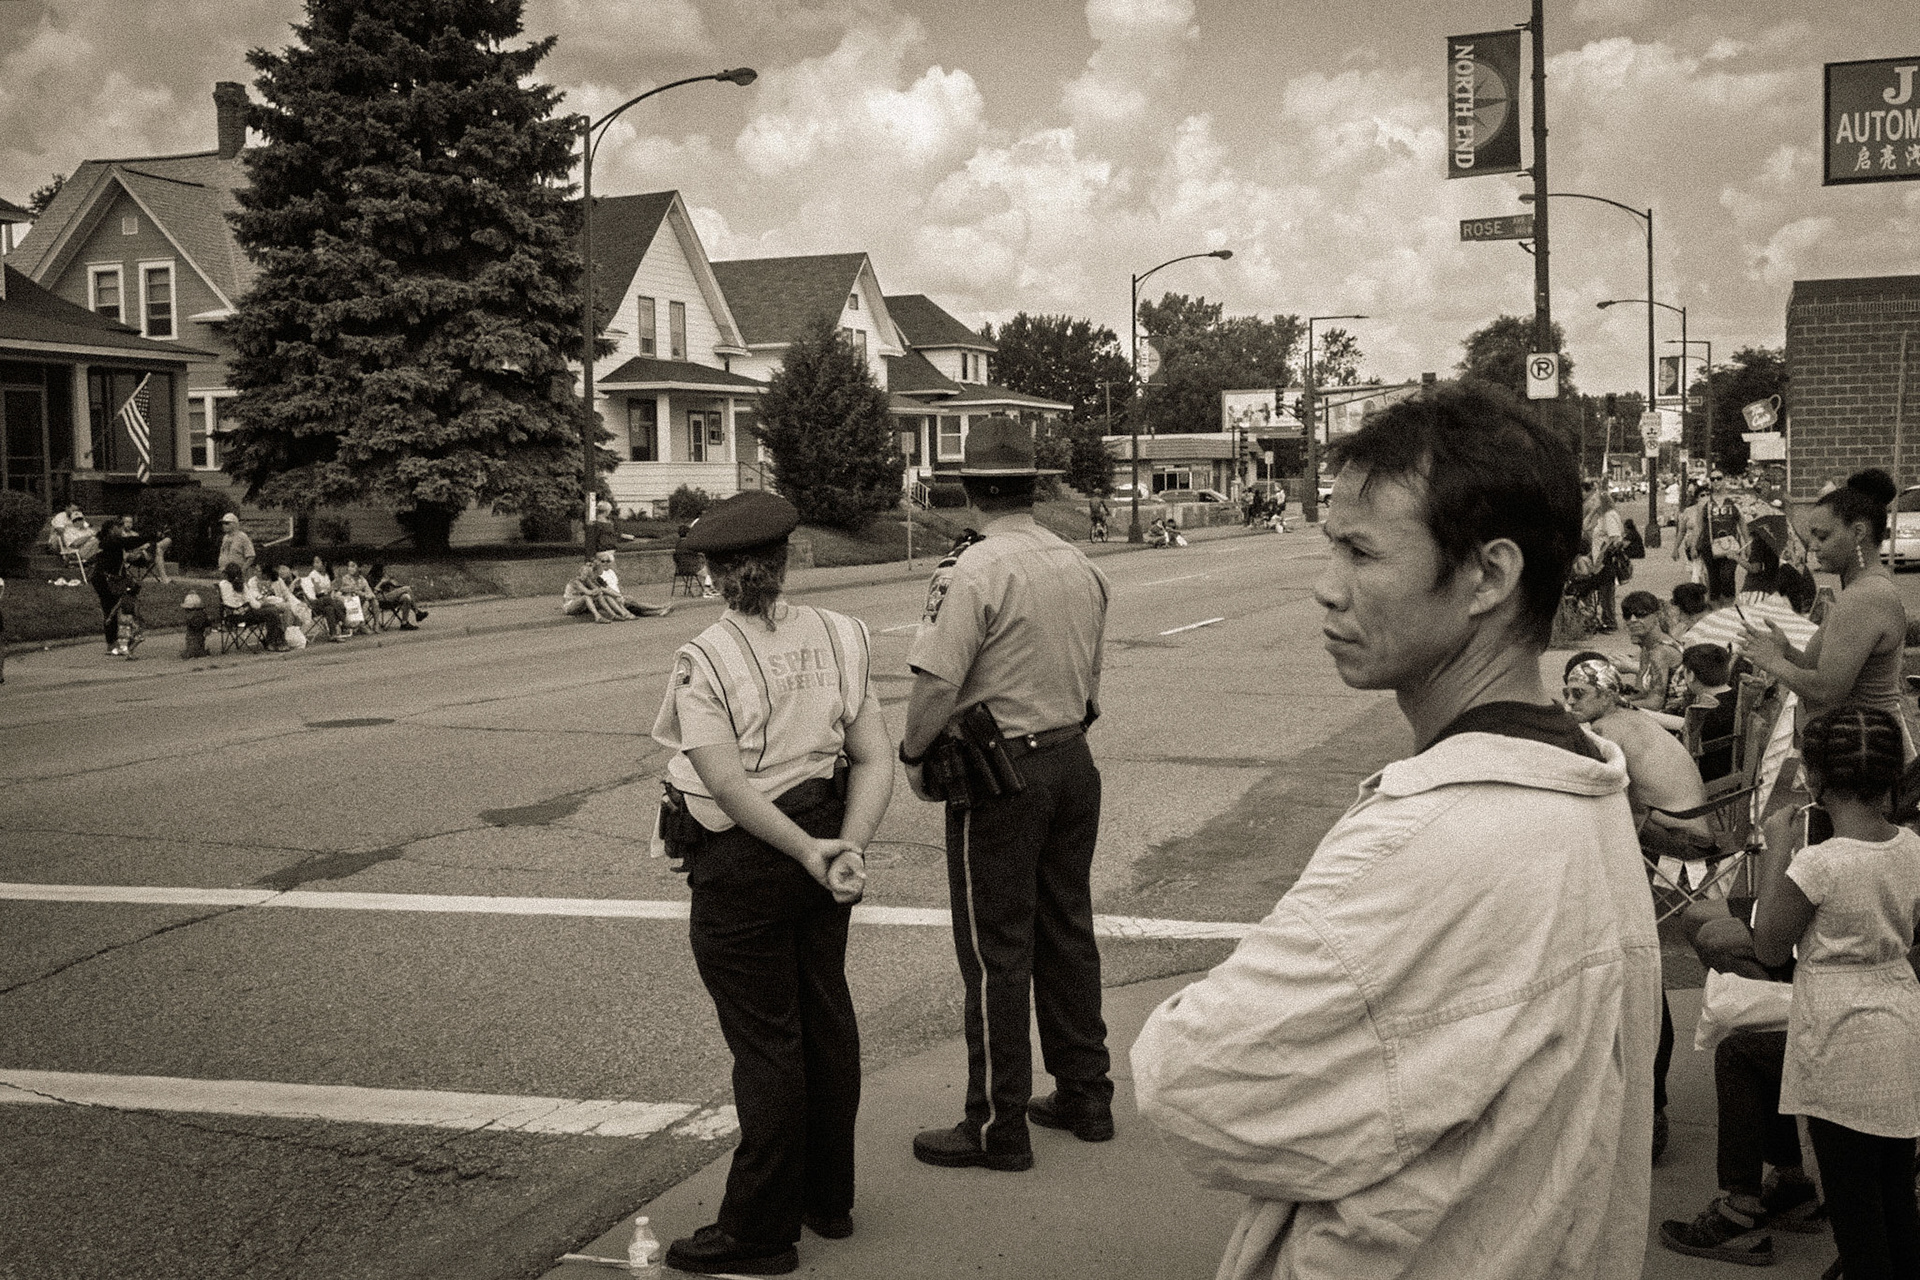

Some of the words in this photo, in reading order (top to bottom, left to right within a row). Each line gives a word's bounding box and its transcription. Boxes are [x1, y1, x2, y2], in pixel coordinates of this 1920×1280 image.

[1454, 44, 1475, 118] NORTH
[1835, 108, 1920, 145] AUTOM
[1454, 125, 1475, 169] END
[1463, 220, 1504, 237] ROSE
